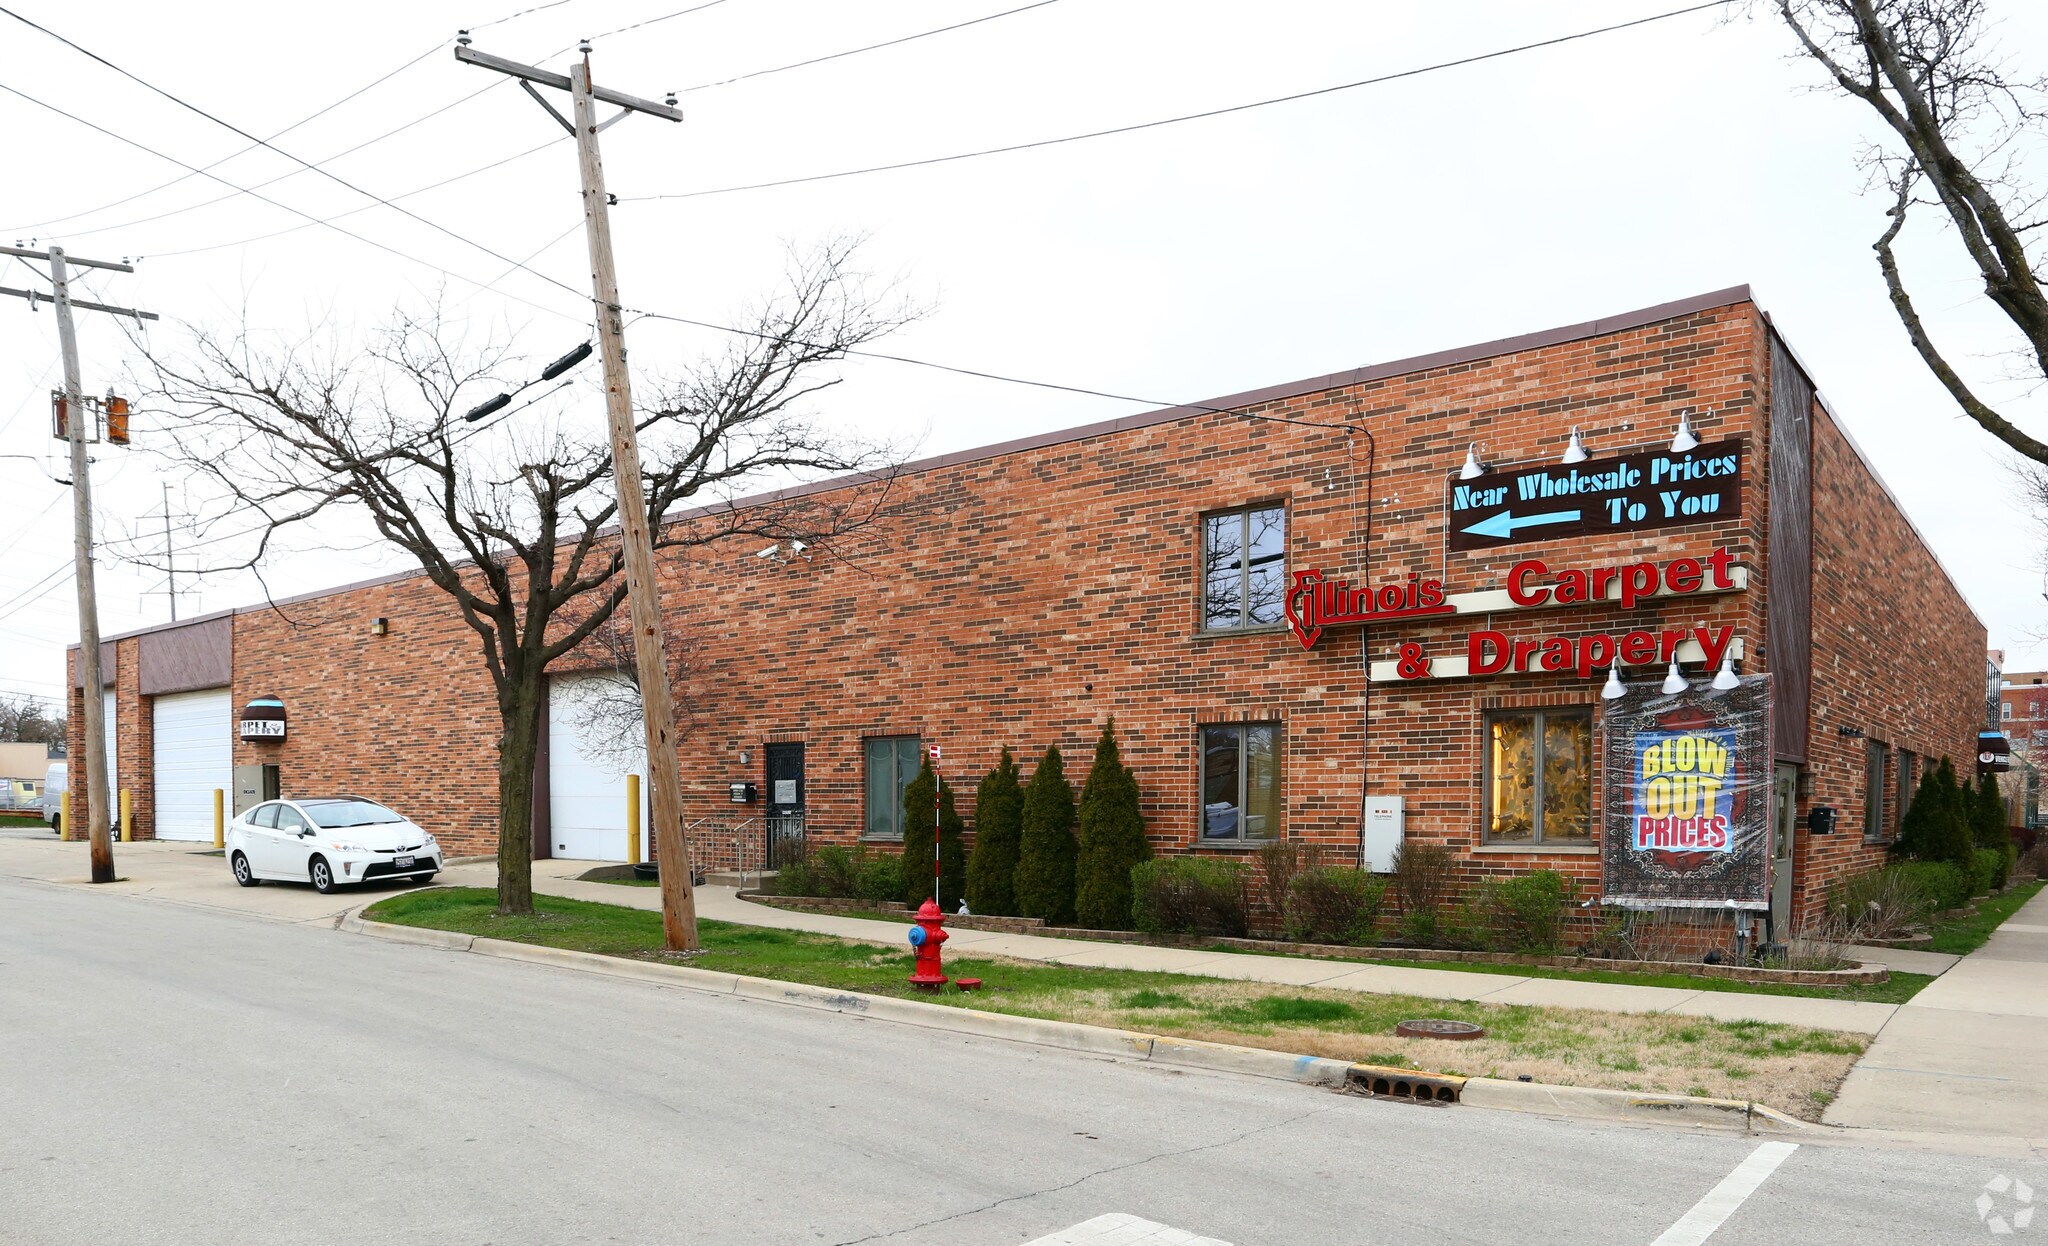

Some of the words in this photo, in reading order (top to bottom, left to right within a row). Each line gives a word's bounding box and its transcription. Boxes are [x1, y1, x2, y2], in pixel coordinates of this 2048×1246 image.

[1453, 485, 1508, 511] Near
[1517, 468, 1641, 501] Wholesale
[1650, 453, 1737, 485] Prices
[1606, 496, 1647, 525] To
[1660, 491, 1720, 518] You
[1507, 546, 1734, 608] Carpet
[1396, 642, 1431, 680] &
[1468, 625, 1735, 679] Drapery
[1643, 735, 1728, 780] BLOW
[1646, 775, 1723, 821] OUT
[1639, 815, 1727, 848] PRICES
